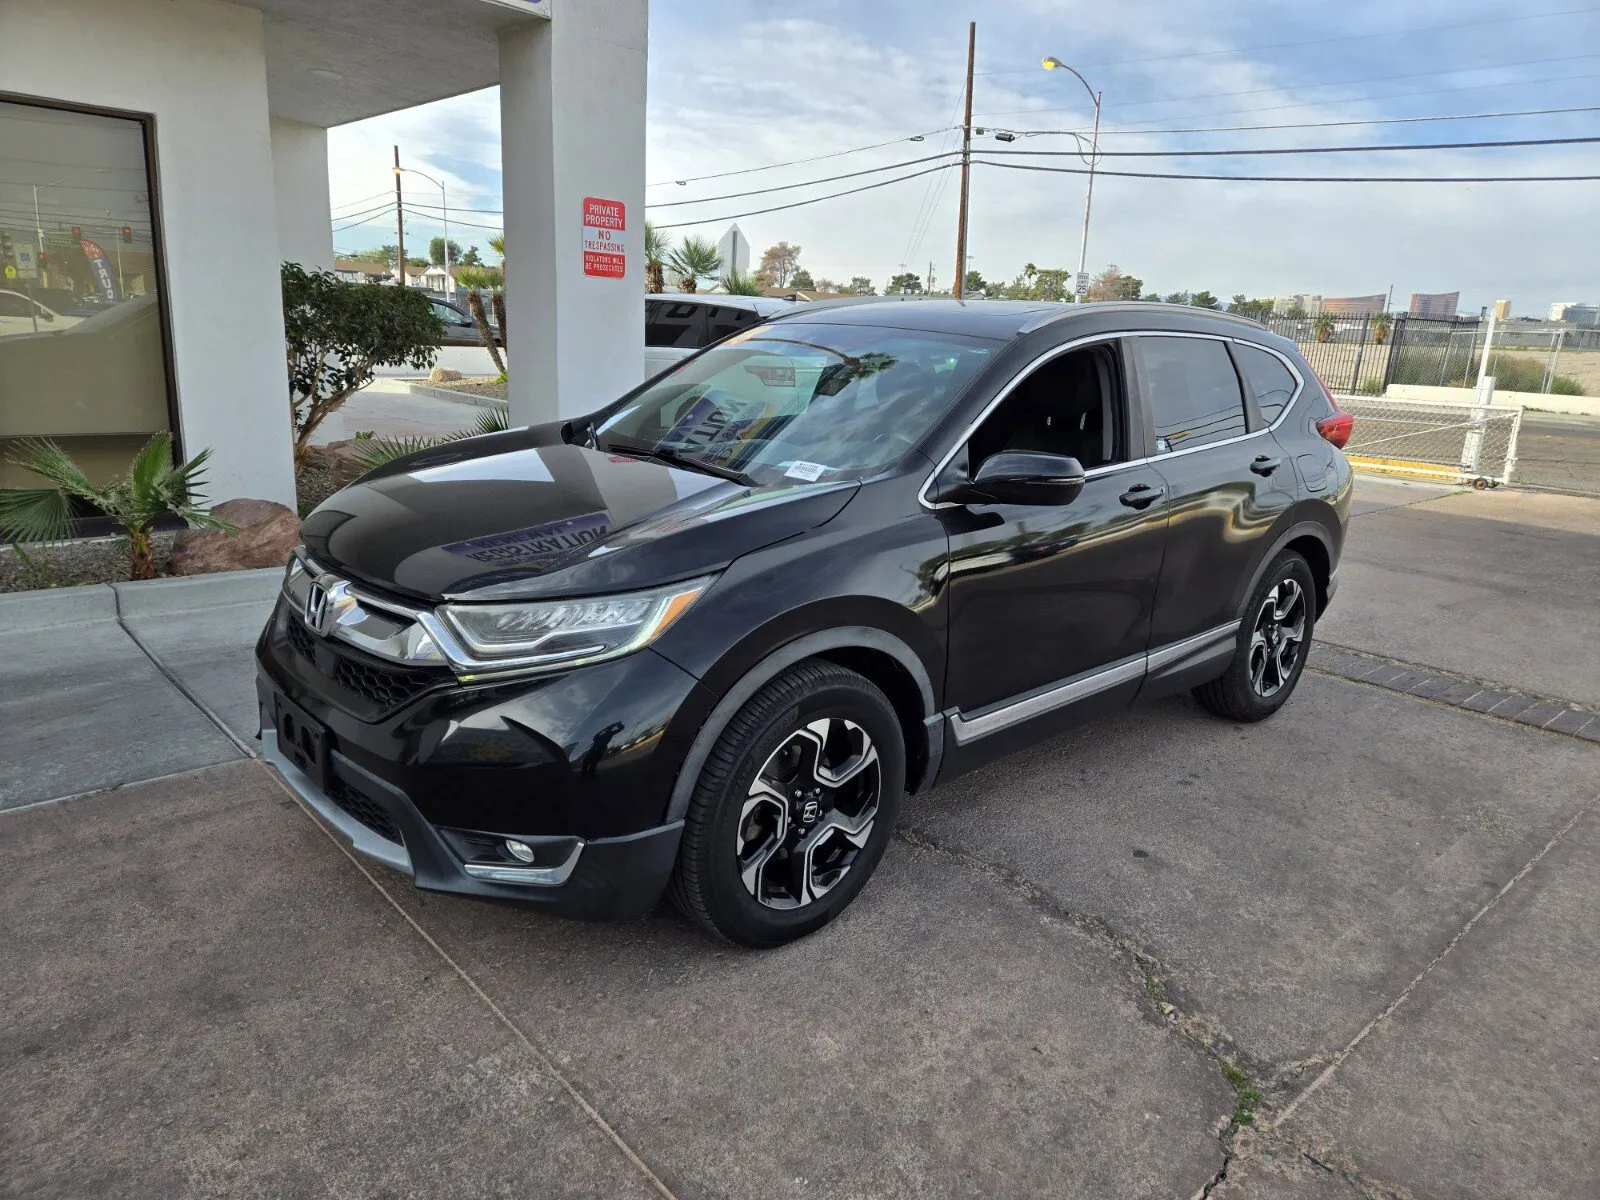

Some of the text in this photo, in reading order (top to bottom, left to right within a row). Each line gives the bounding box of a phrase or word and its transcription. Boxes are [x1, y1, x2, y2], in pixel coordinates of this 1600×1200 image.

[589, 204, 619, 217] PRIVATE
[585, 214, 623, 228] PROPERTY
[598, 230, 611, 240] NO
[585, 240, 624, 252] TRESPASSING
[585, 255, 624, 265] VIOLATORS WILL
[1077, 285, 1087, 294] 25
